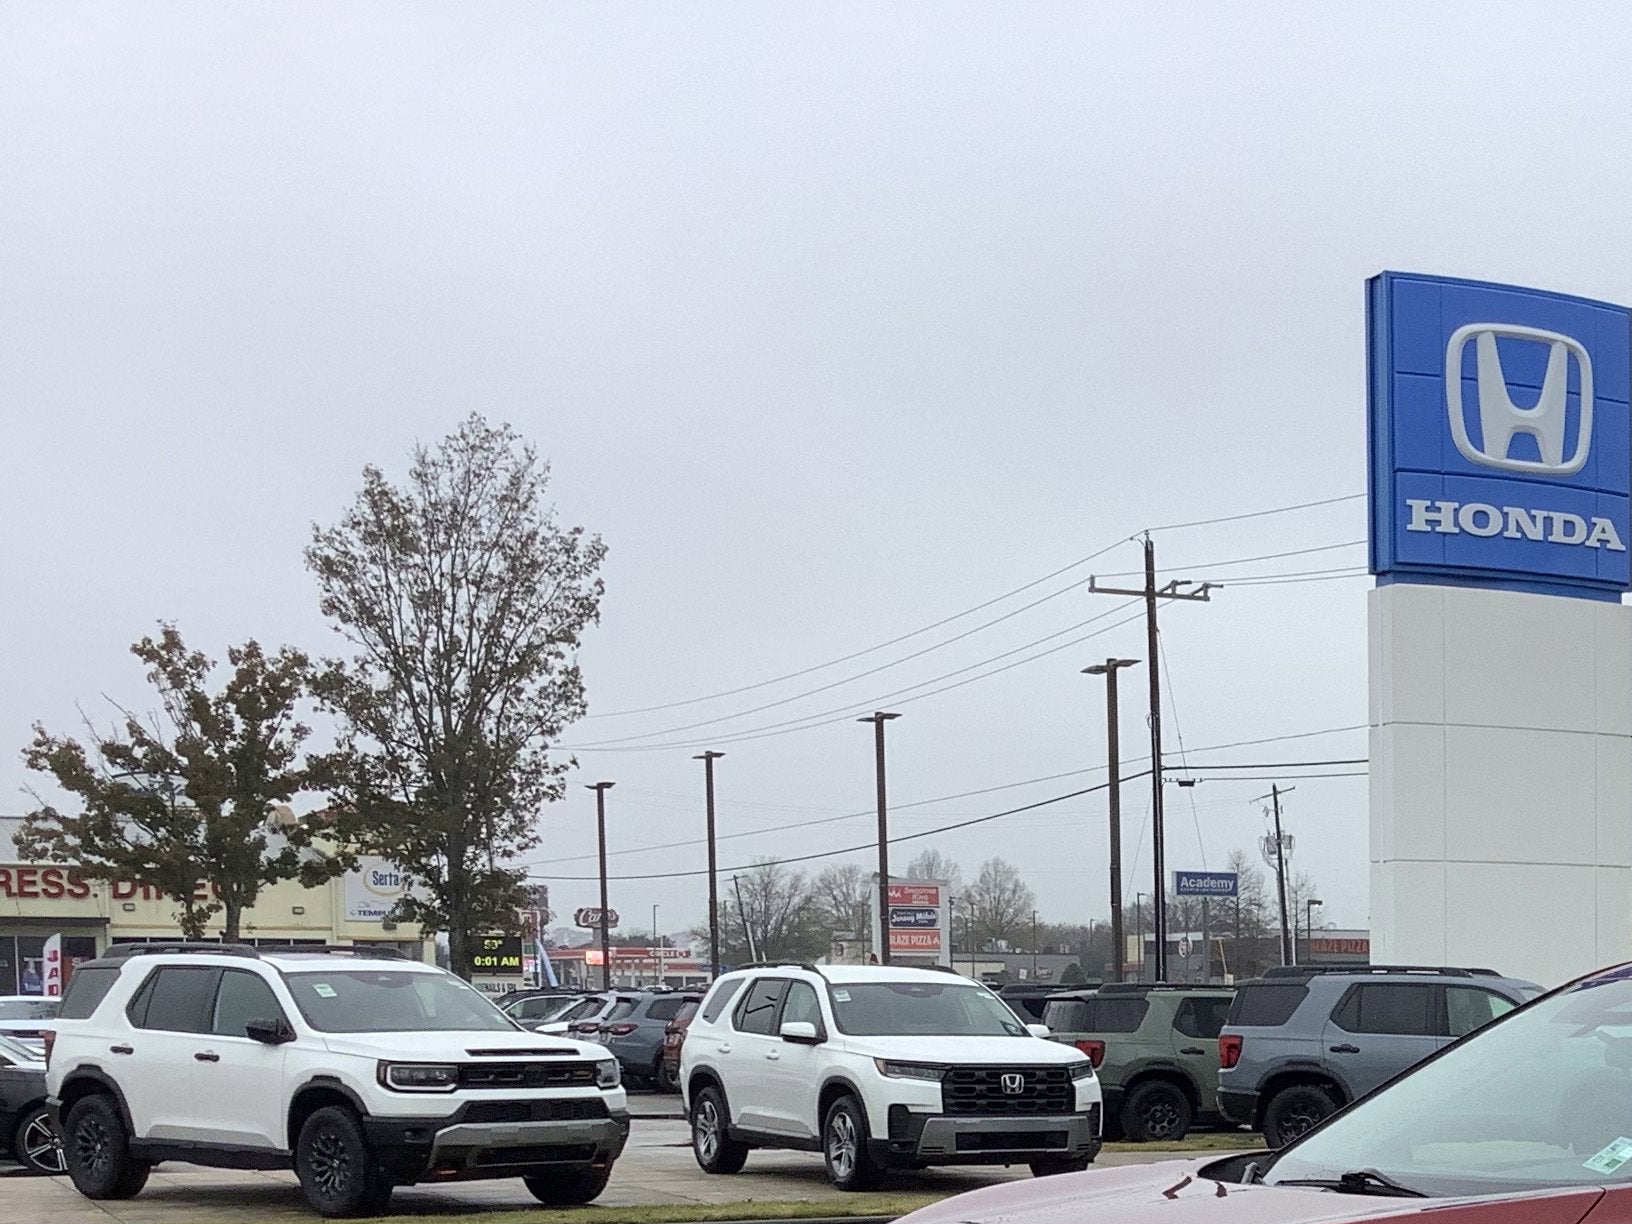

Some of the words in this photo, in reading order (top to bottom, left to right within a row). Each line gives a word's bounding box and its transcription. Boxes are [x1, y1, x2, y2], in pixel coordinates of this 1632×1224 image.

[1405, 499, 1627, 552] HONDA
[372, 870, 400, 887] Serta
[1180, 876, 1234, 891] Academy
[911, 933, 932, 946] PIZZA
[500, 956, 520, 967] AM
